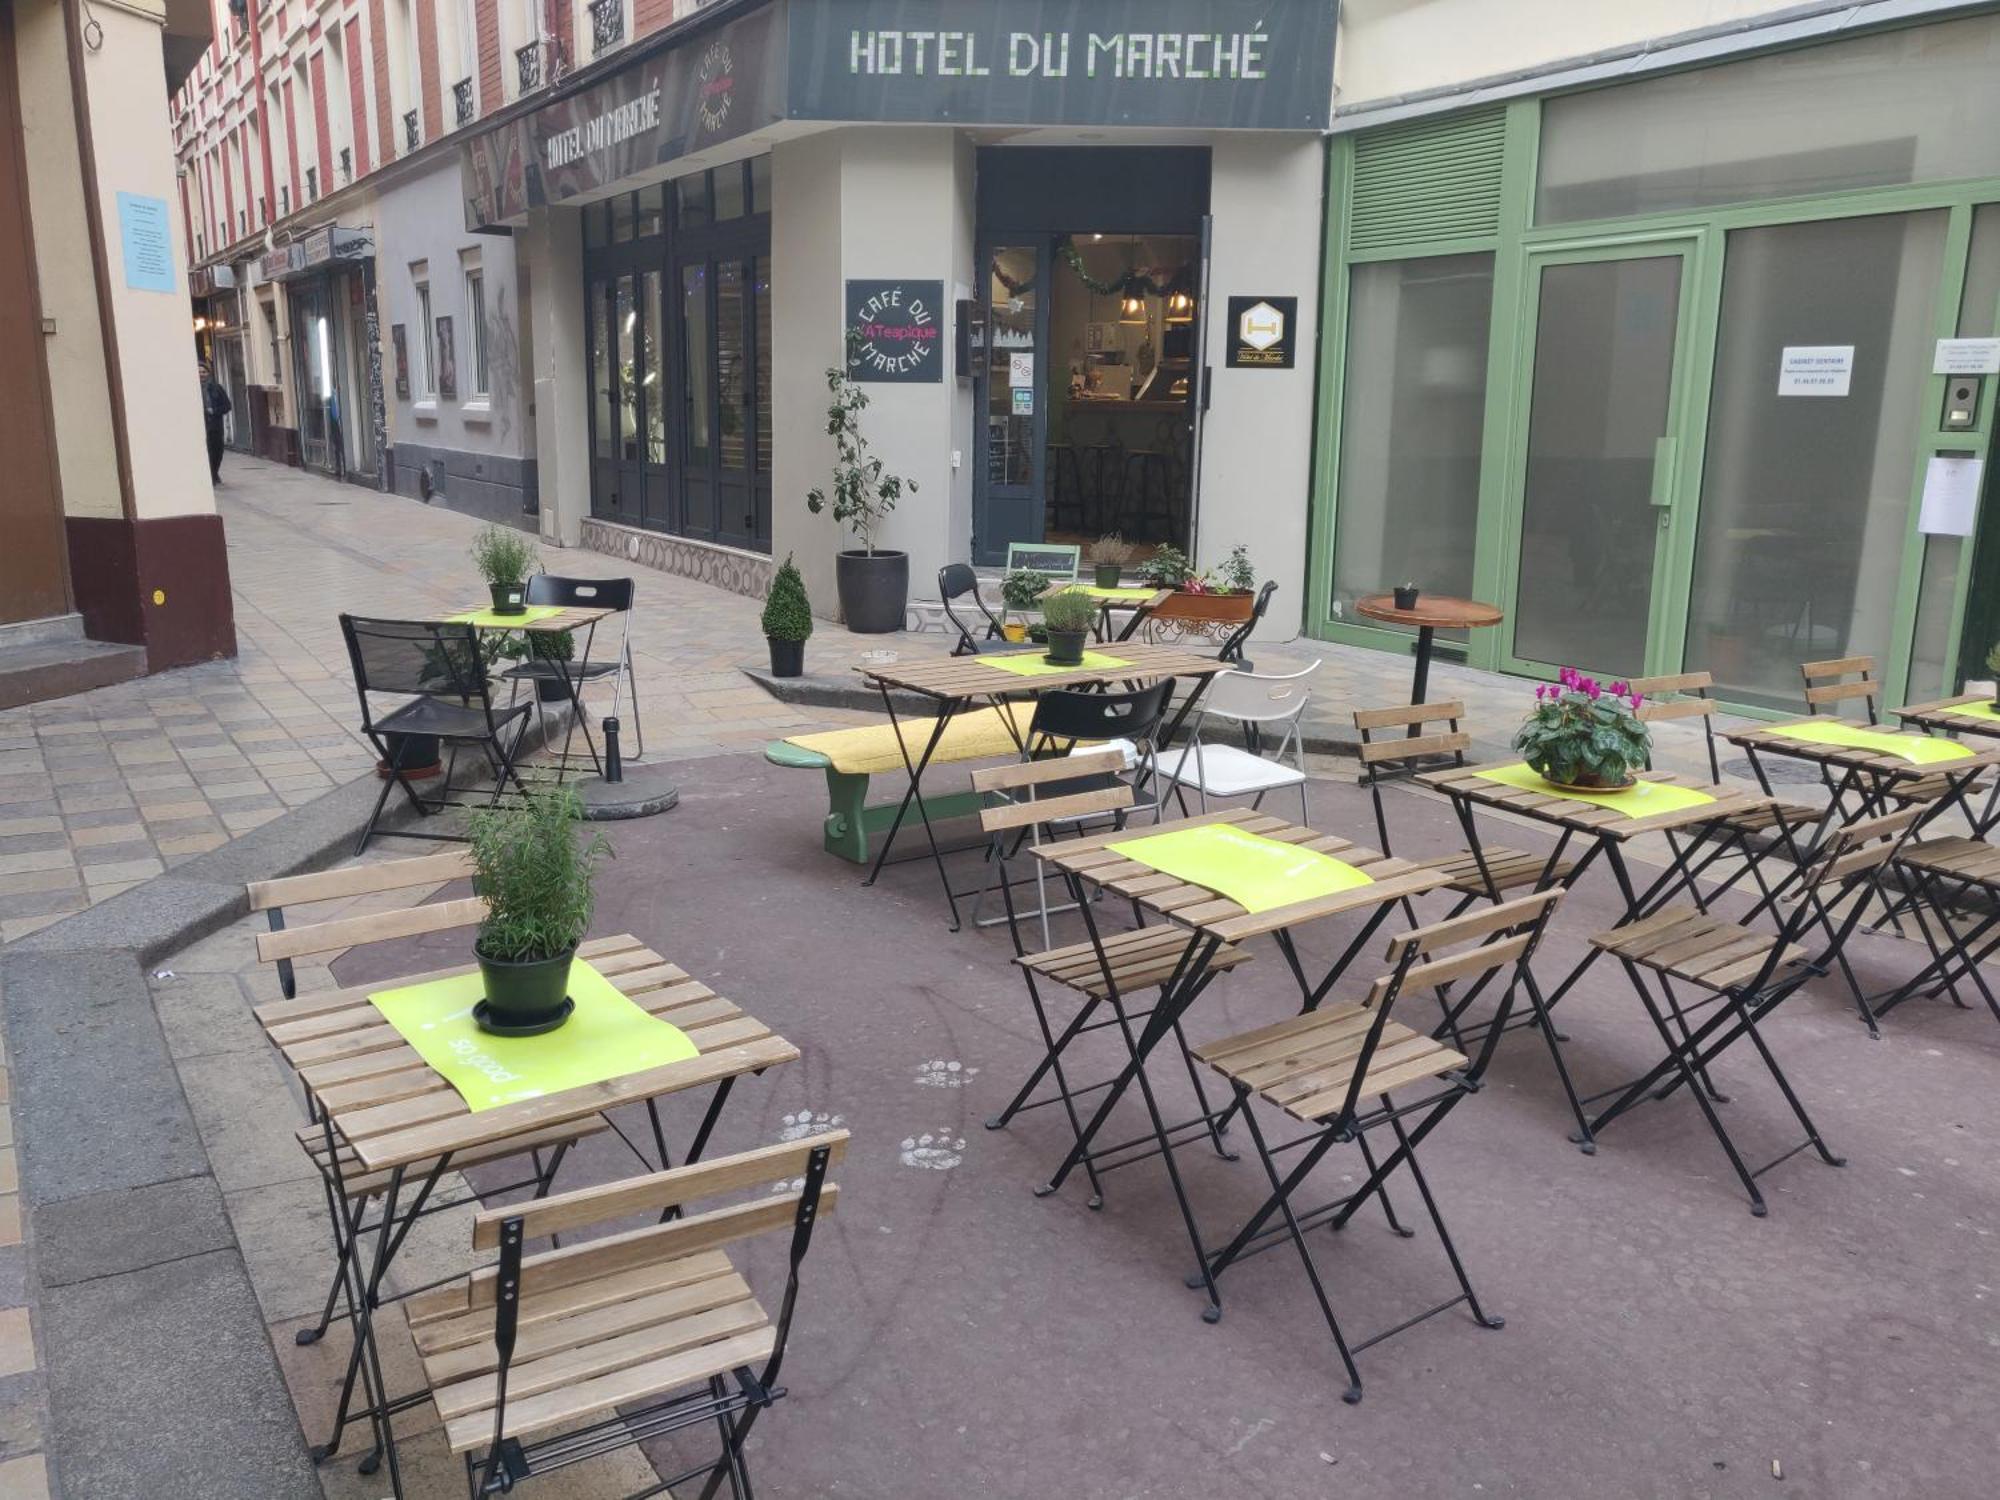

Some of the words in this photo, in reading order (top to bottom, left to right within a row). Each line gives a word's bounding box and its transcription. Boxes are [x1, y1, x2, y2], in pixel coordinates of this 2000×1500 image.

[851, 30, 990, 76] HOTEL
[1009, 32, 1069, 78] DU
[1087, 19, 1269, 80] MARCHÉ
[547, 126, 584, 170] HOTEL
[859, 286, 902, 322] CAFÉ
[909, 299, 932, 325] DU
[861, 339, 931, 373] MARCHÉ
